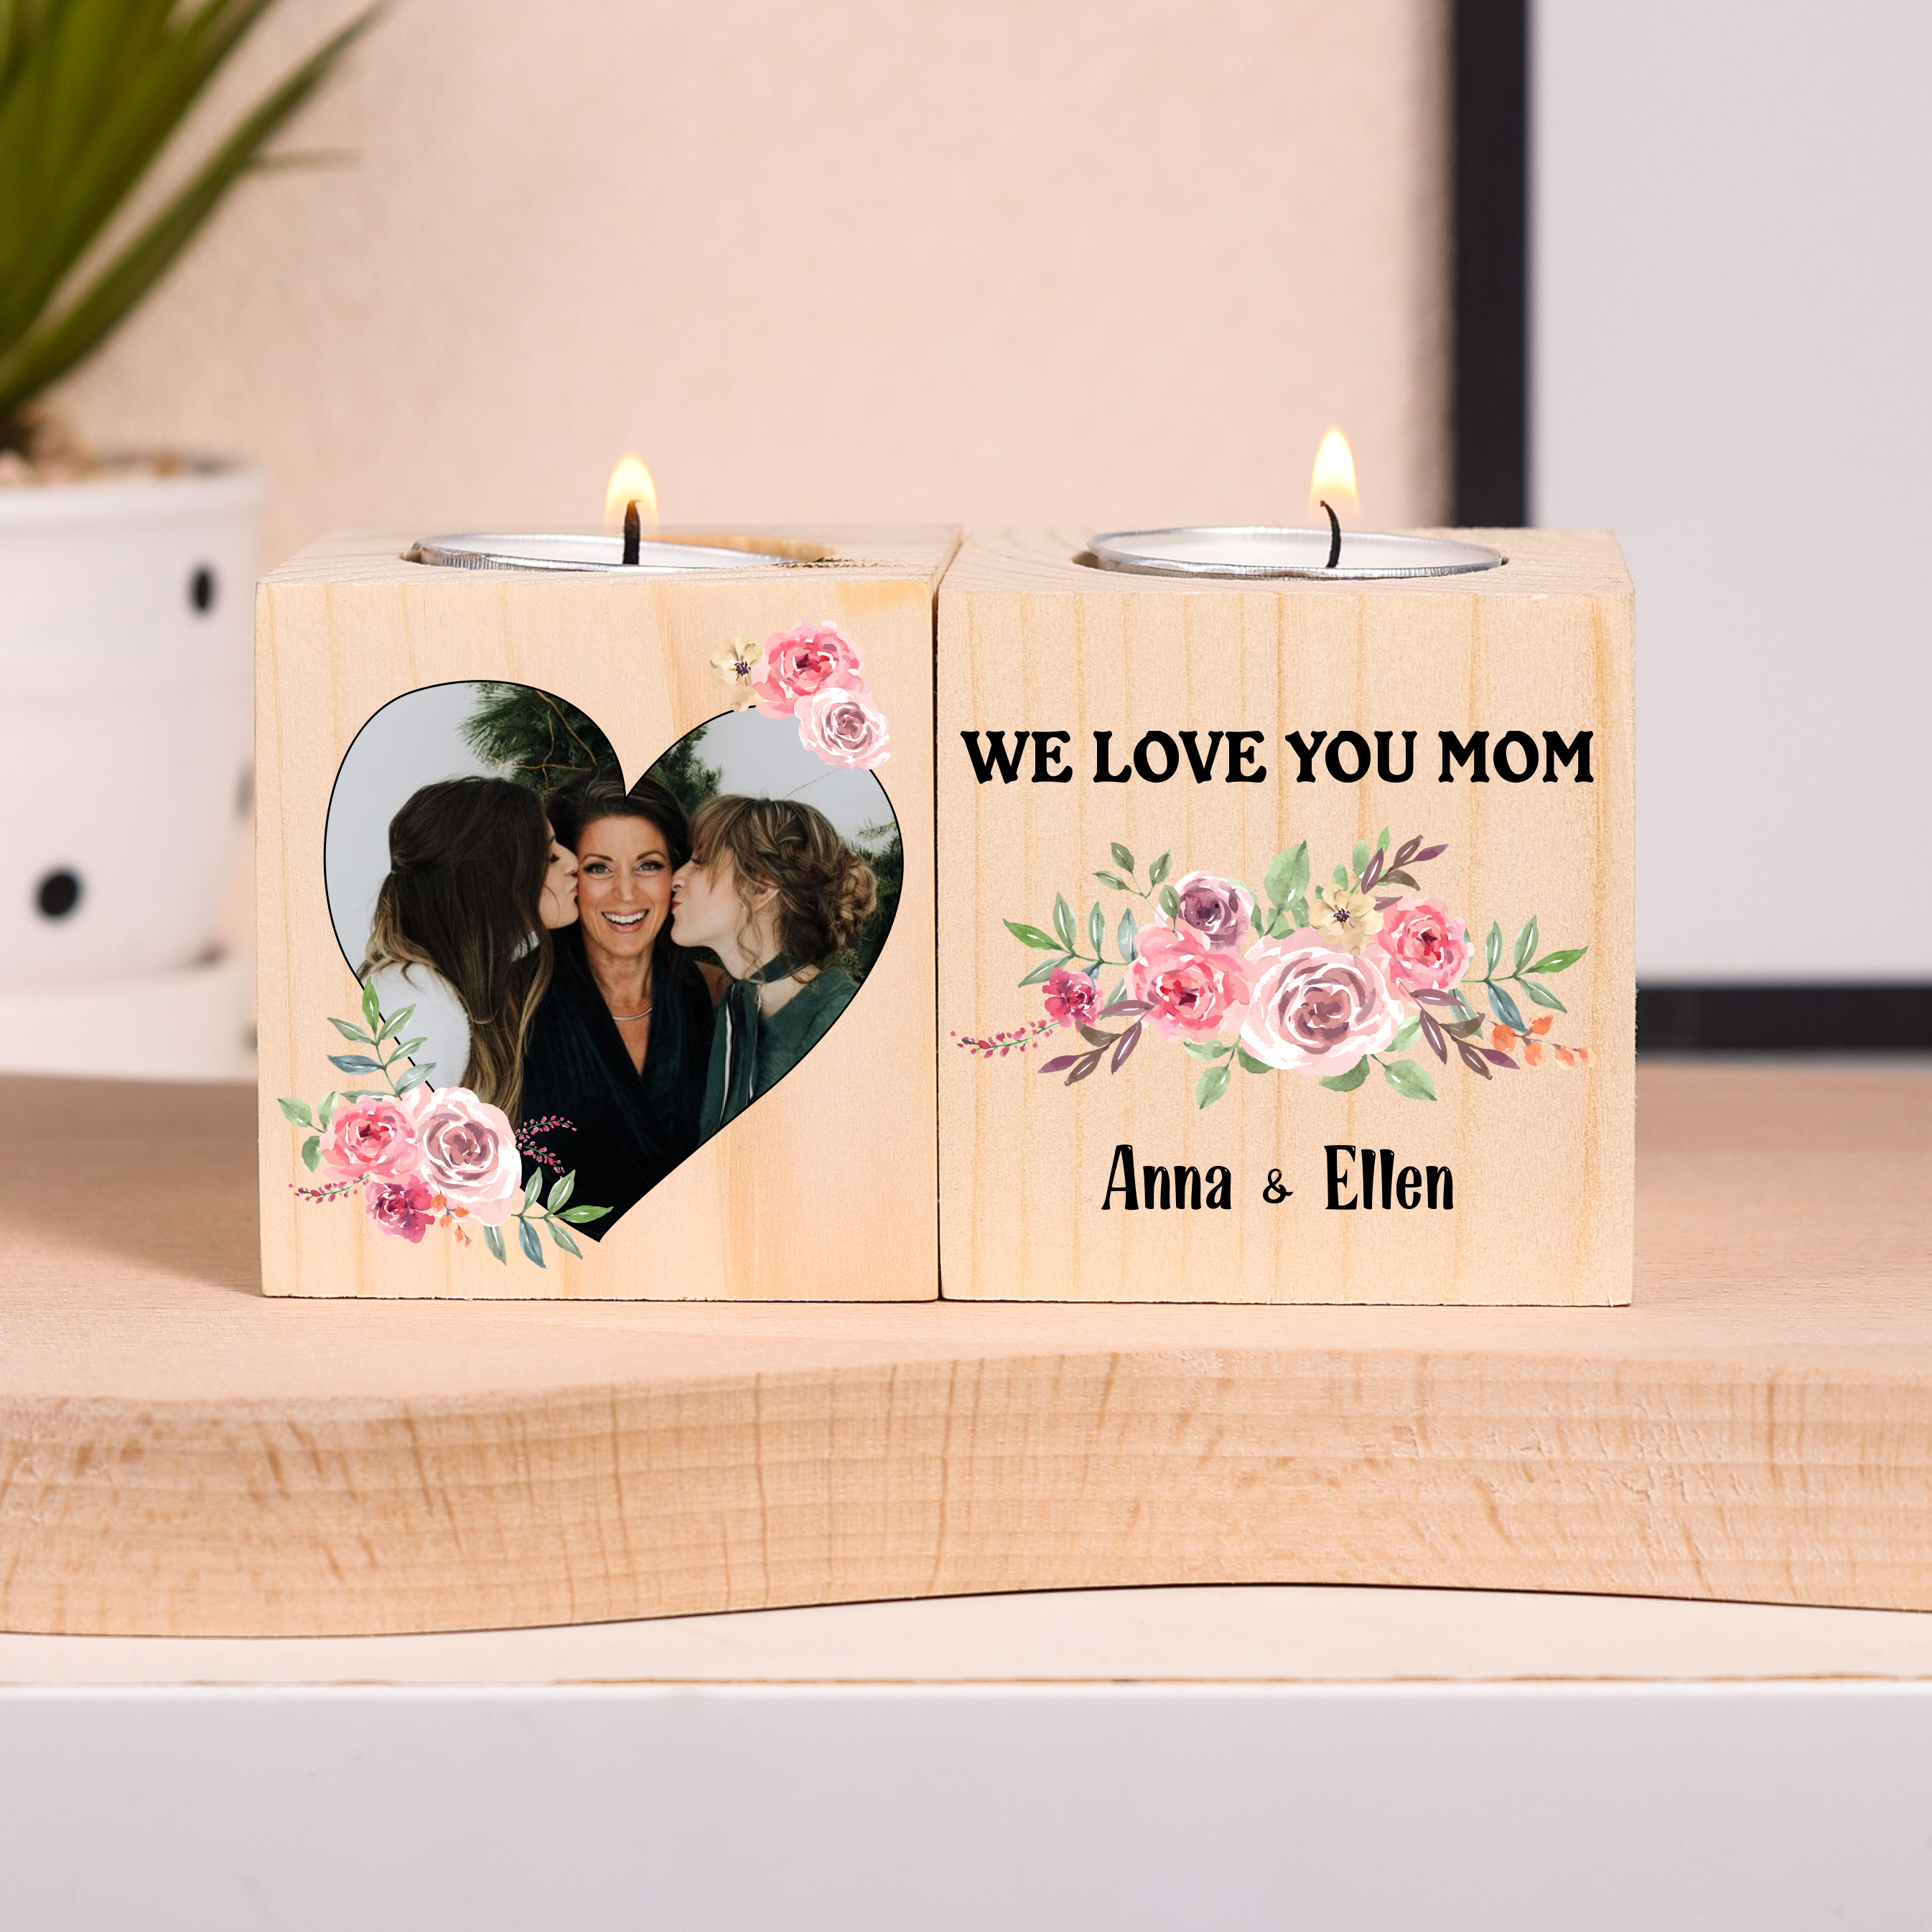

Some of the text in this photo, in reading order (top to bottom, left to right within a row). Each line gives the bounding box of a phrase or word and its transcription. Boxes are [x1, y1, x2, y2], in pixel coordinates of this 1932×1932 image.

[961, 730, 1595, 785] WE LOVE YOU MOM
[1101, 1144, 1454, 1210] Anna & Ellen
